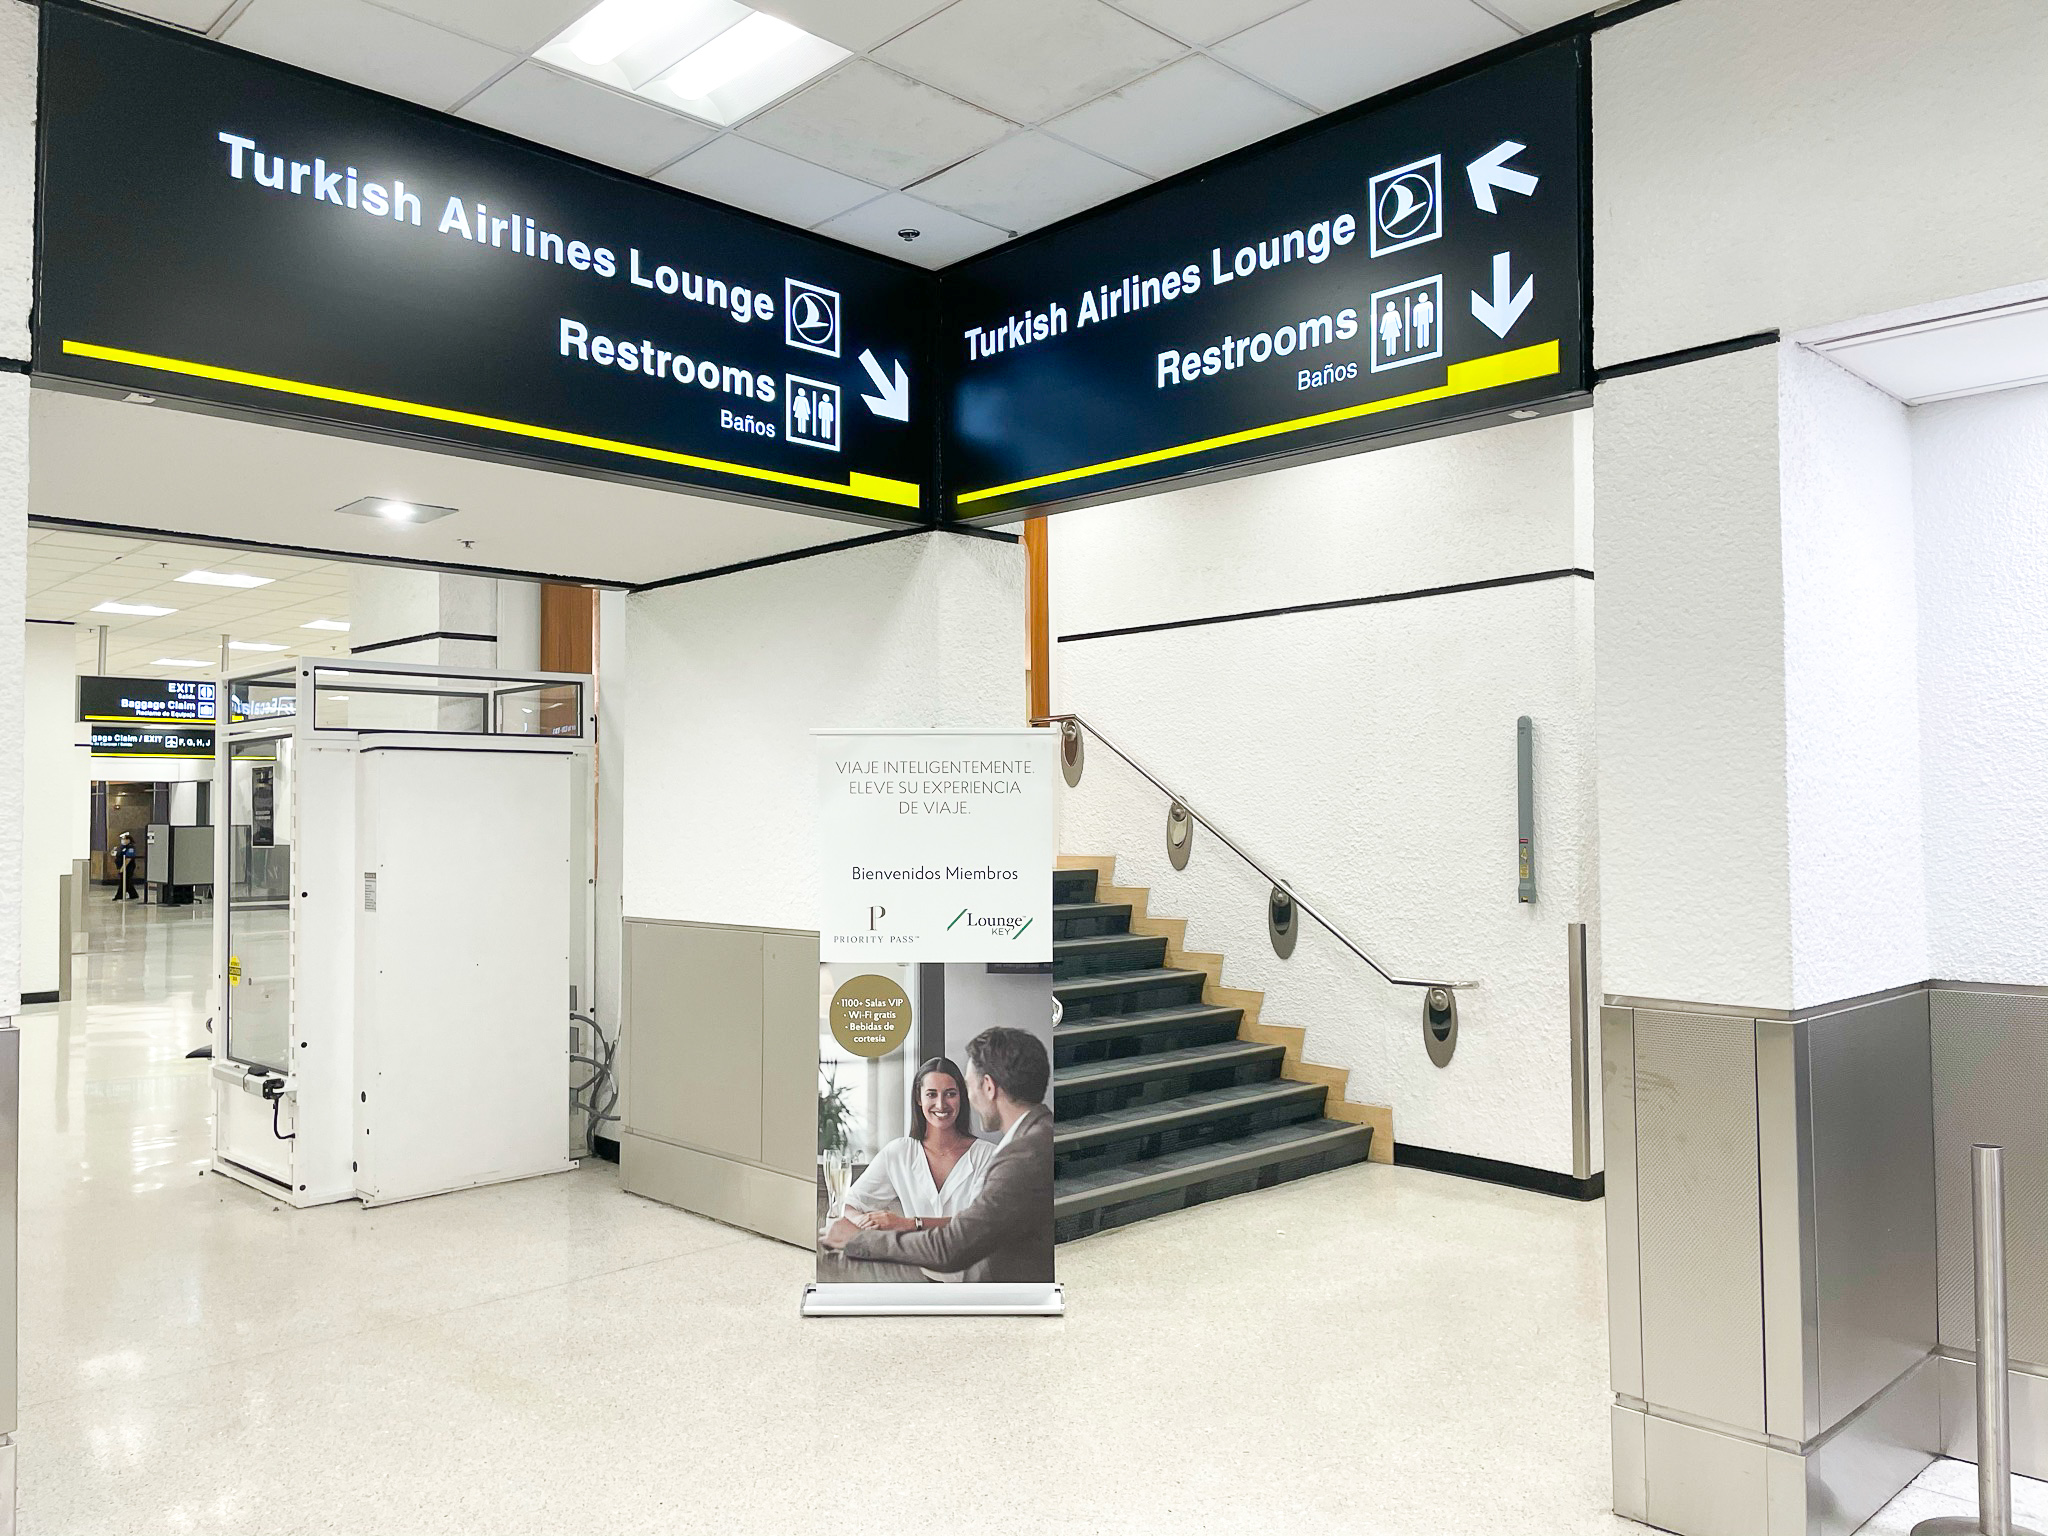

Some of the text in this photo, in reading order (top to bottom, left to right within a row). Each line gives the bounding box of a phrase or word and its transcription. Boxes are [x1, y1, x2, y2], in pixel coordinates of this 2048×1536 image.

[218, 131, 774, 323] Turkish Airlines Lounge
[964, 213, 1357, 361] Turkish Airlines Lounge
[1157, 308, 1359, 388] Restrooms
[559, 317, 776, 402] Restrooms
[1297, 360, 1358, 391] Baños
[720, 408, 776, 438] Baños
[168, 682, 196, 693] EXIT
[121, 698, 196, 710] Baggage Claim
[92, 734, 112, 743] gage
[114, 734, 138, 743] Claim
[143, 735, 163, 743] EXIT
[836, 760, 1035, 774] VIAJE INTELIGENTEMENTE.
[849, 781, 1021, 794] ELEVE SU EXPERIENCIA
[899, 801, 971, 814] DE VIAJE.
[852, 865, 1019, 880] Bienvenidos Miembros
[991, 927, 1011, 936] KEY
[833, 935, 884, 943] PRIORITY
[865, 998, 887, 1007] Salas
[888, 998, 904, 1007] VIP
[848, 1010, 896, 1021] Wi-Fi gratis
[849, 1021, 895, 1031] Bebidas de
[853, 1034, 886, 1042] cortesía
